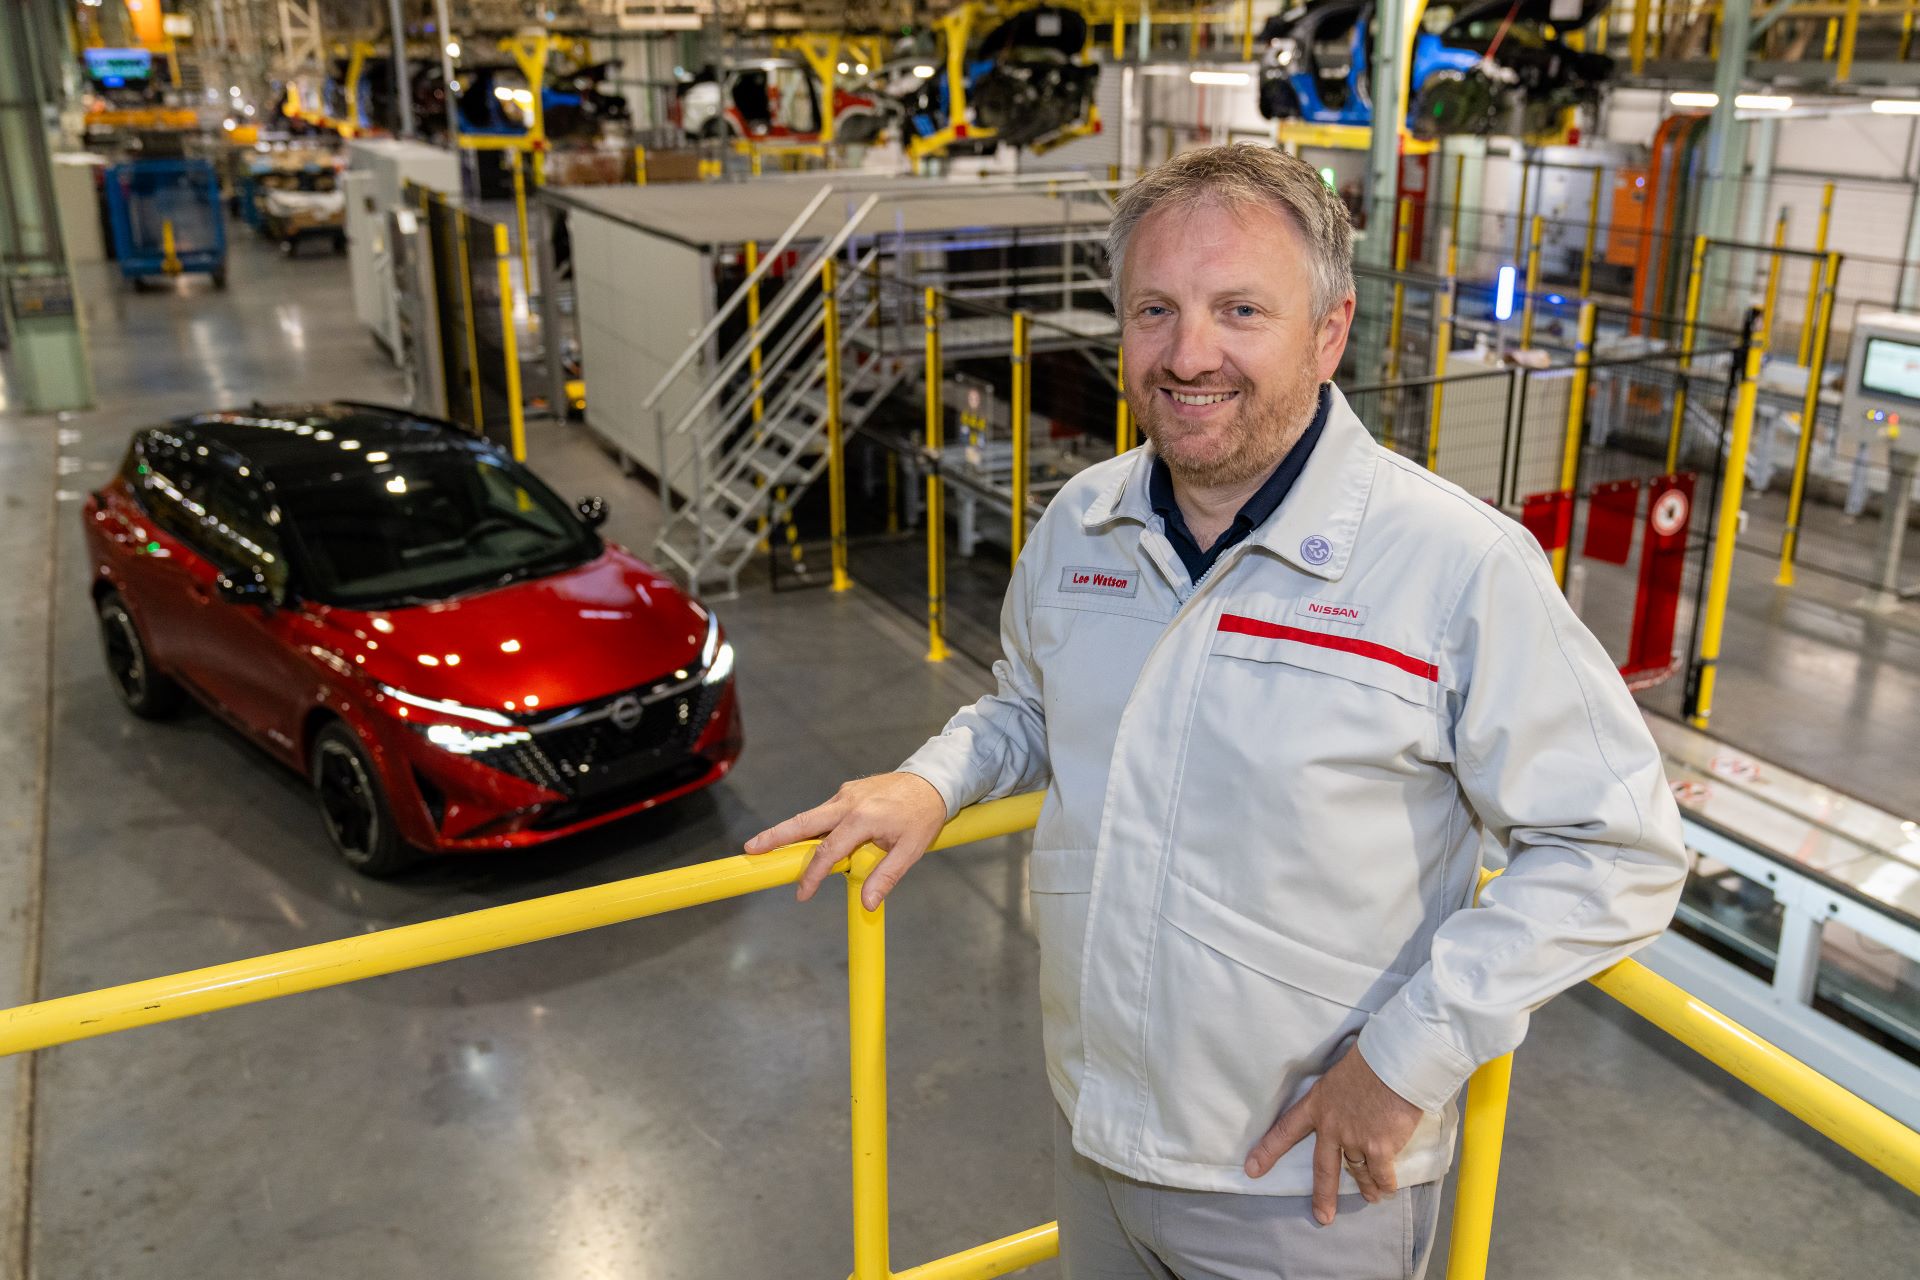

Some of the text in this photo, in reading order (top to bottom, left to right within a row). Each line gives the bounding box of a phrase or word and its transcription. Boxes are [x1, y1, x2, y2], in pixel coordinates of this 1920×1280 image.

[1307, 540, 1328, 559] 25
[1072, 573, 1128, 589] Lee Watson
[1308, 603, 1359, 619] NISSAN
